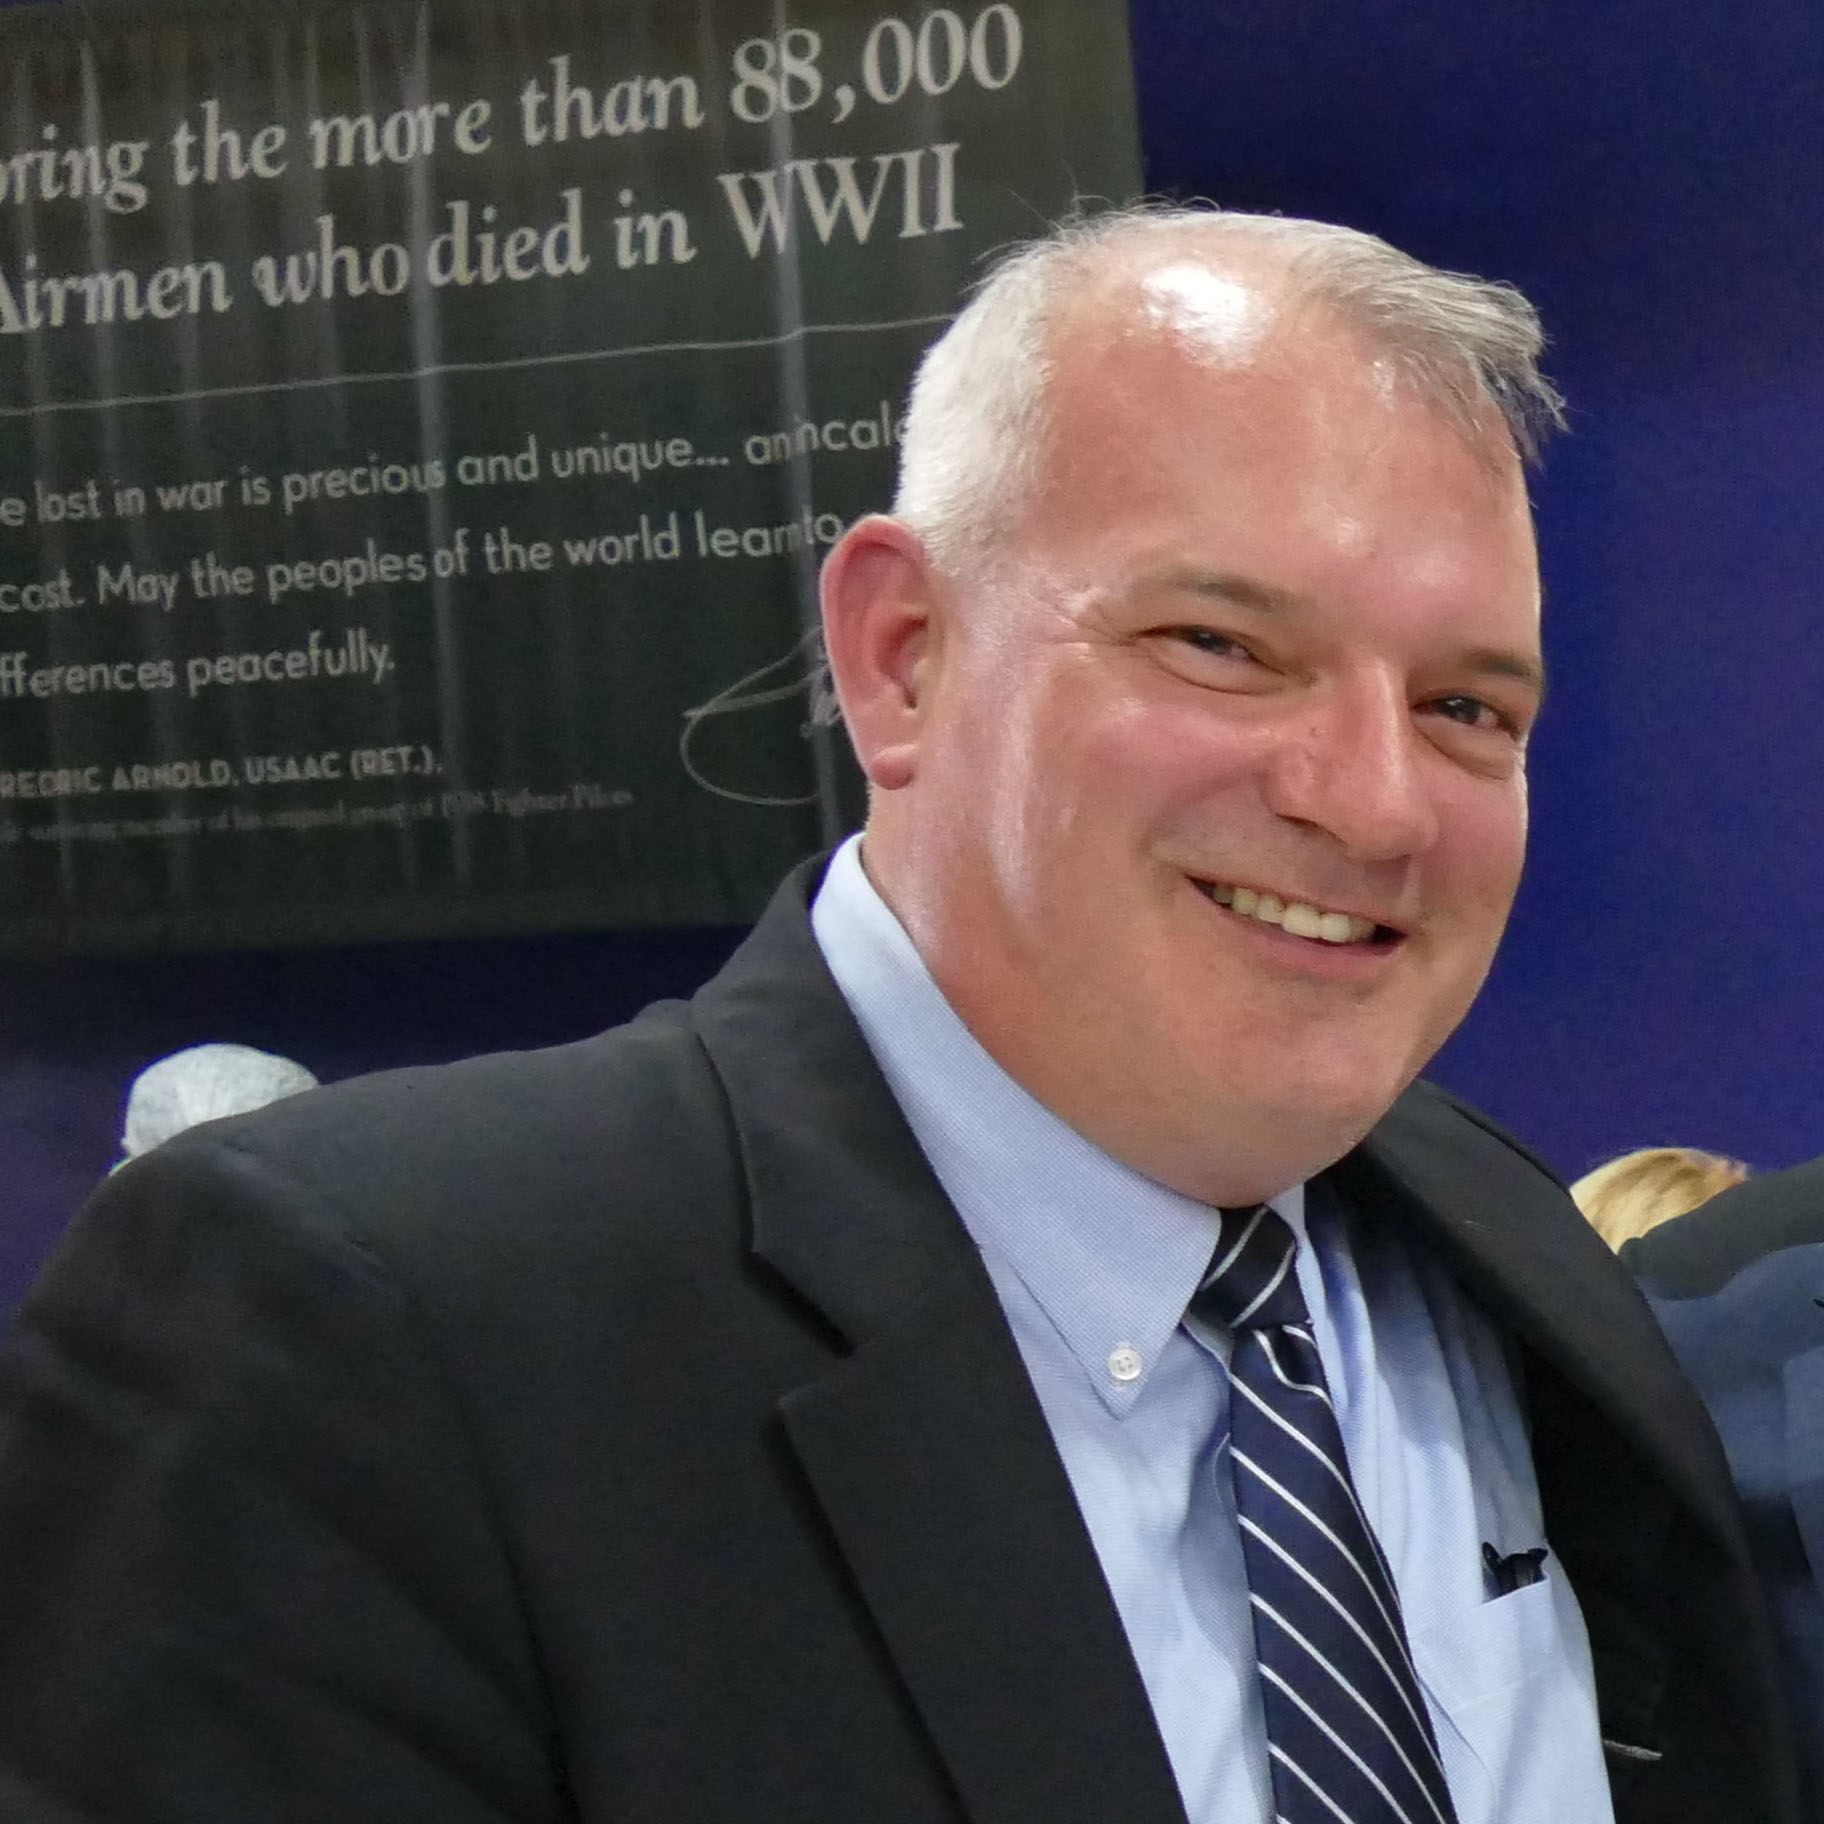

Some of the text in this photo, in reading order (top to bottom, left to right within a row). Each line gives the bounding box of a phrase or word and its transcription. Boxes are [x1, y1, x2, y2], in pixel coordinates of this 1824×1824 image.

[172, 99, 289, 186] the
[310, 99, 492, 170] more
[520, 54, 706, 147] than
[730, 4, 1023, 124] 88,000
[252, 213, 411, 307] who
[427, 187, 591, 287] died
[614, 188, 698, 270] in
[716, 142, 965, 261] WWII
[35, 477, 103, 524] lost
[113, 476, 146, 518] in
[155, 479, 229, 512] war
[240, 464, 272, 506] is
[282, 452, 447, 516] precious
[457, 431, 540, 486] and
[97, 562, 180, 612] May
[190, 549, 256, 599] the
[268, 536, 428, 606] peoples
[432, 526, 472, 579] of
[483, 525, 554, 576] the
[562, 510, 681, 567] world
[186, 626, 397, 700] peacefully.
